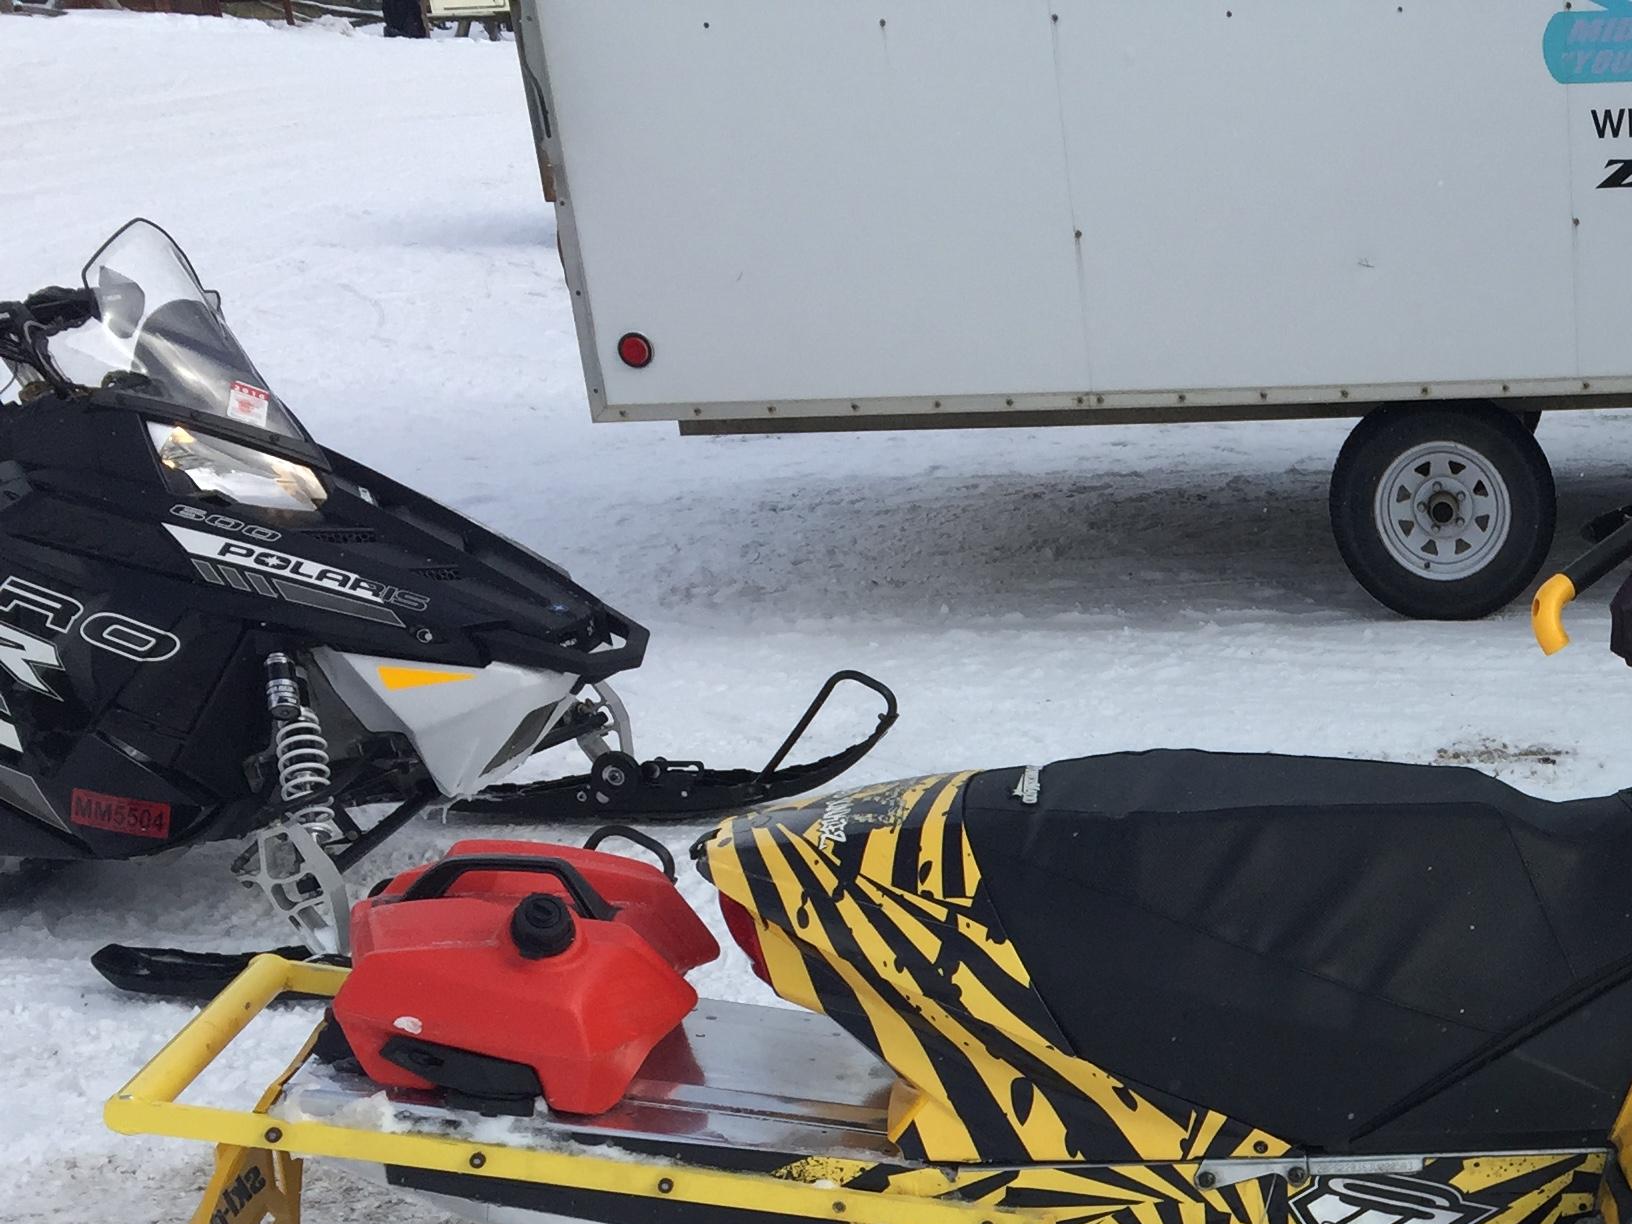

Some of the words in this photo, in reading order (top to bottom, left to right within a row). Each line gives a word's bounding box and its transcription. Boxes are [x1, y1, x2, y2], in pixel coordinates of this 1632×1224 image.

[168, 504, 282, 542] 600
[217, 541, 430, 613] POLARIS
[75, 796, 164, 833] MM5504
